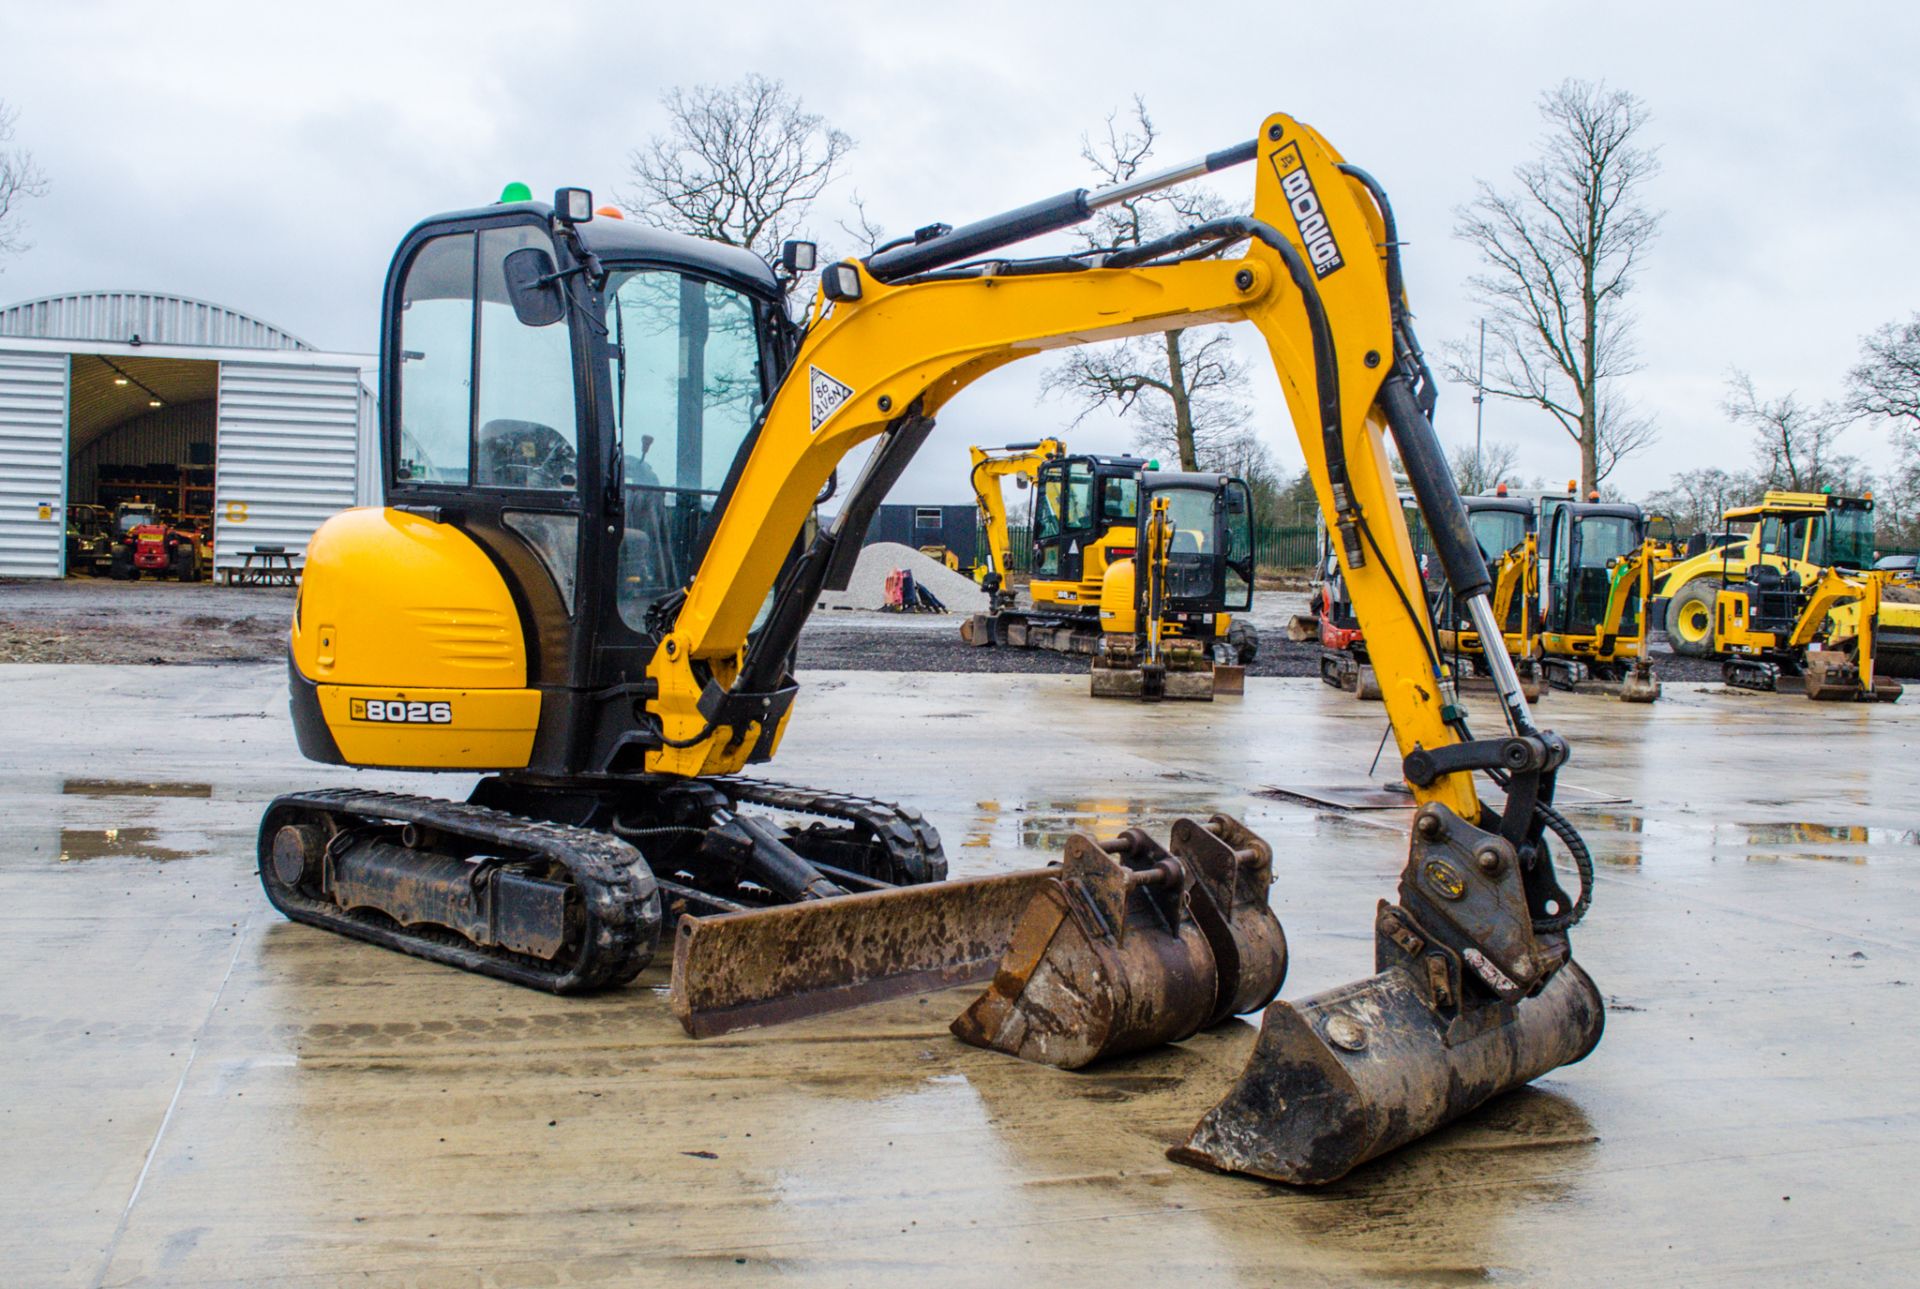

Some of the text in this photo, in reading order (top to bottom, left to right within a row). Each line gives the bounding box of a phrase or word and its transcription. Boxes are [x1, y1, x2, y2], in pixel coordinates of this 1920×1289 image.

[1282, 168, 1337, 265] 8026
[1316, 255, 1341, 274] CTS
[815, 381, 829, 398] 86
[815, 386, 842, 416] AV6N
[225, 501, 248, 523] 8
[367, 701, 452, 721] 8026
